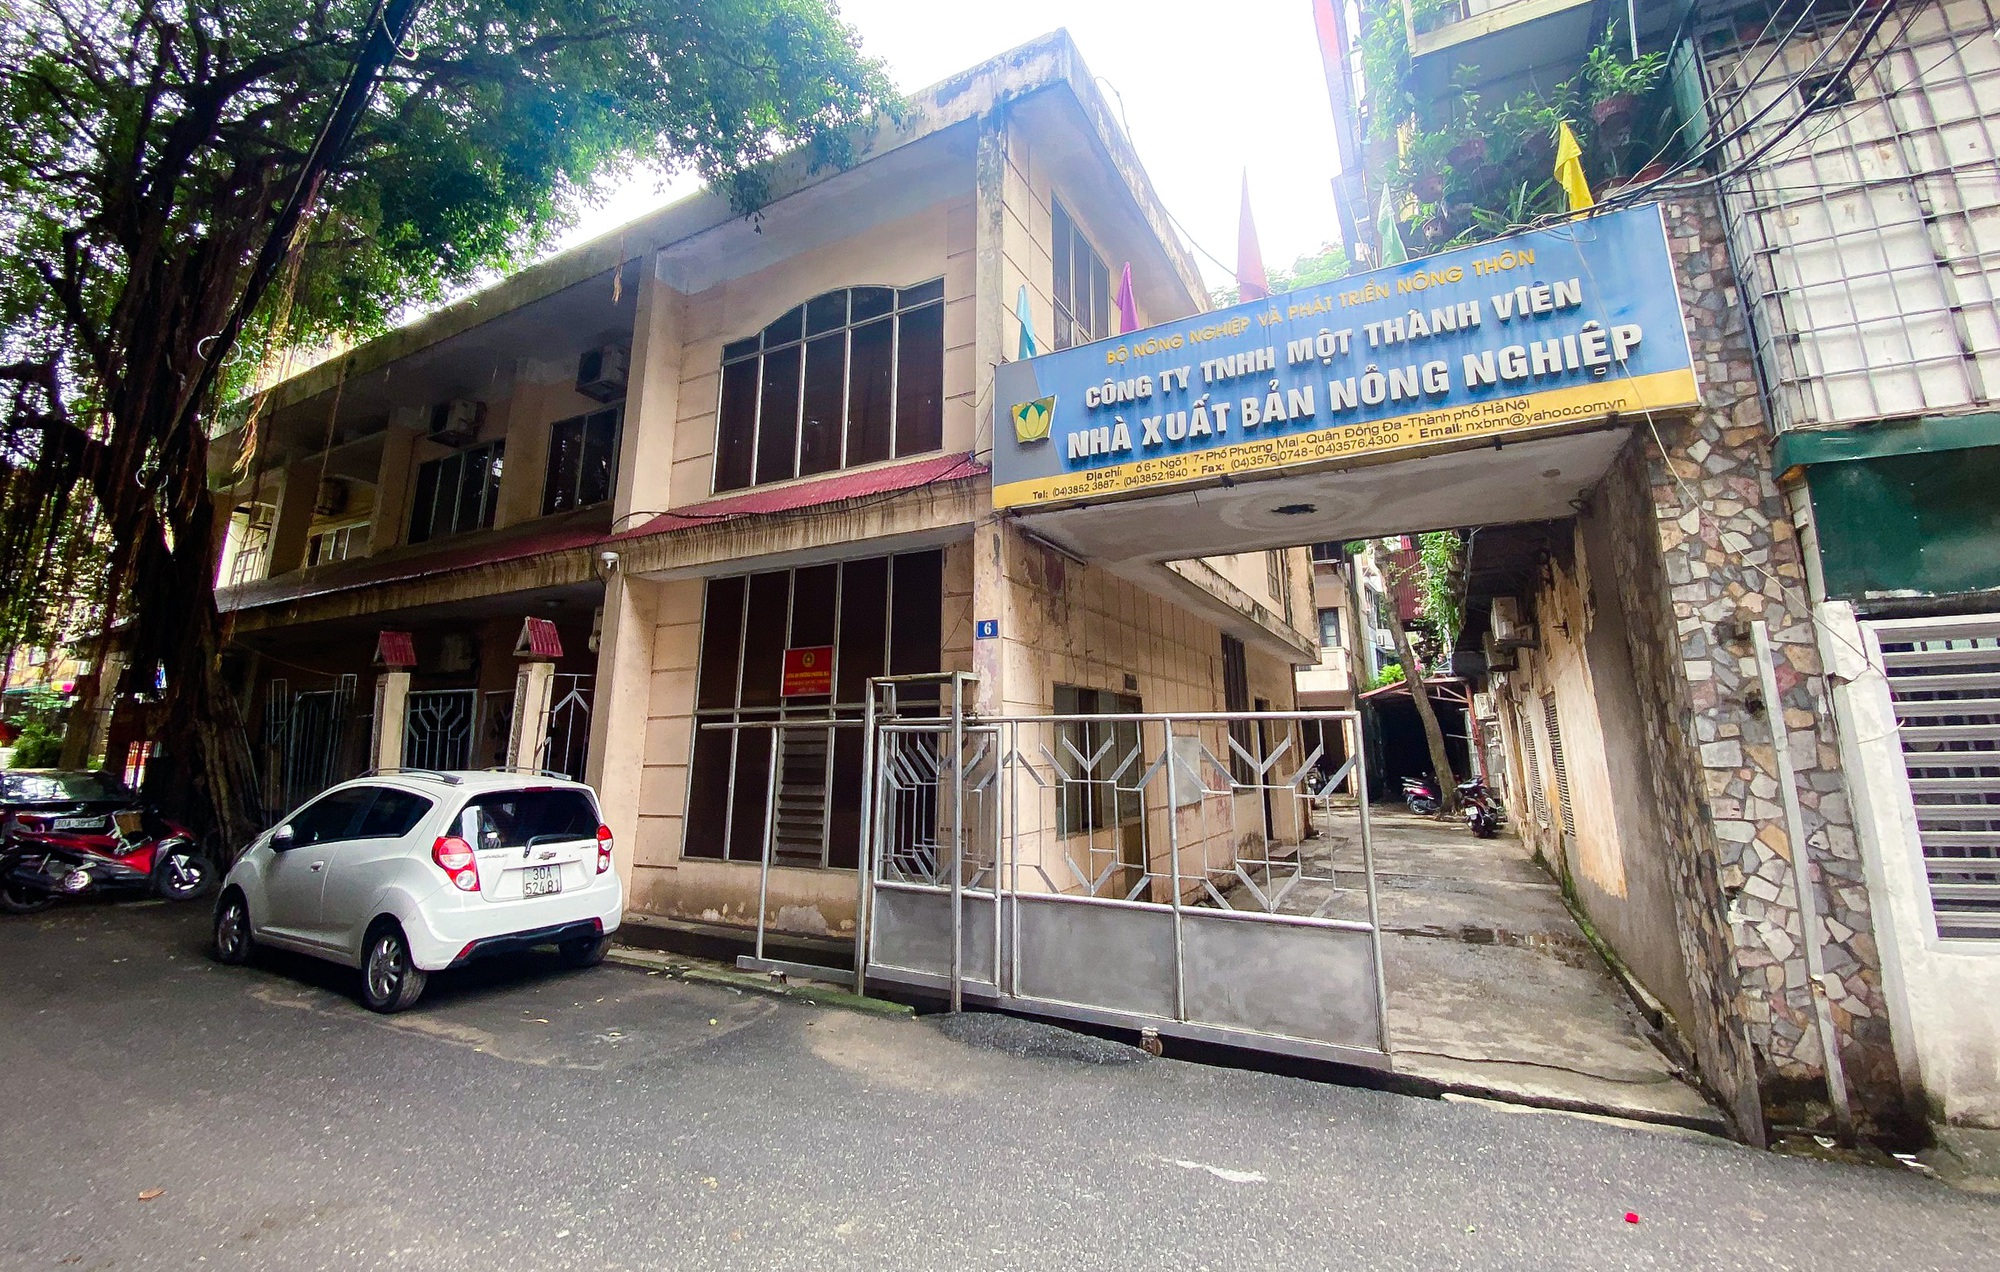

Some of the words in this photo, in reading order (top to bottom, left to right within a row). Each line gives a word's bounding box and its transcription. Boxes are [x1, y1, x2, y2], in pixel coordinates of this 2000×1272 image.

[1107, 345, 1128, 365] BỘ
[1133, 333, 1184, 358] NÔNG
[1189, 317, 1250, 345] NGHIỆP
[1256, 306, 1283, 327] VÀ
[1288, 296, 1333, 320] PHÁT
[1339, 279, 1390, 310] TRIỂN
[1396, 267, 1463, 295] NÔNG
[1472, 249, 1535, 277] THÔN
[1067, 416, 1132, 460] NHÀ
[1141, 393, 1231, 446] XUẤT
[1240, 378, 1316, 428] BẢN
[1329, 362, 1449, 412] NÔNG
[1462, 319, 1643, 388] NGHIỆP
[1086, 375, 1153, 408] CÔNG
[1159, 366, 1191, 393] TY
[1200, 346, 1276, 383] TNHH
[1287, 327, 1353, 365] MỘT
[1363, 300, 1482, 347] THÀNH
[1201, 463, 1225, 474] Fax:
[1466, 398, 1627, 431] nxbnn@yahoo.com.vn
[1454, 406, 1480, 423] phố
[984, 622, 992, 635] 6
[533, 866, 552, 881] 30A
